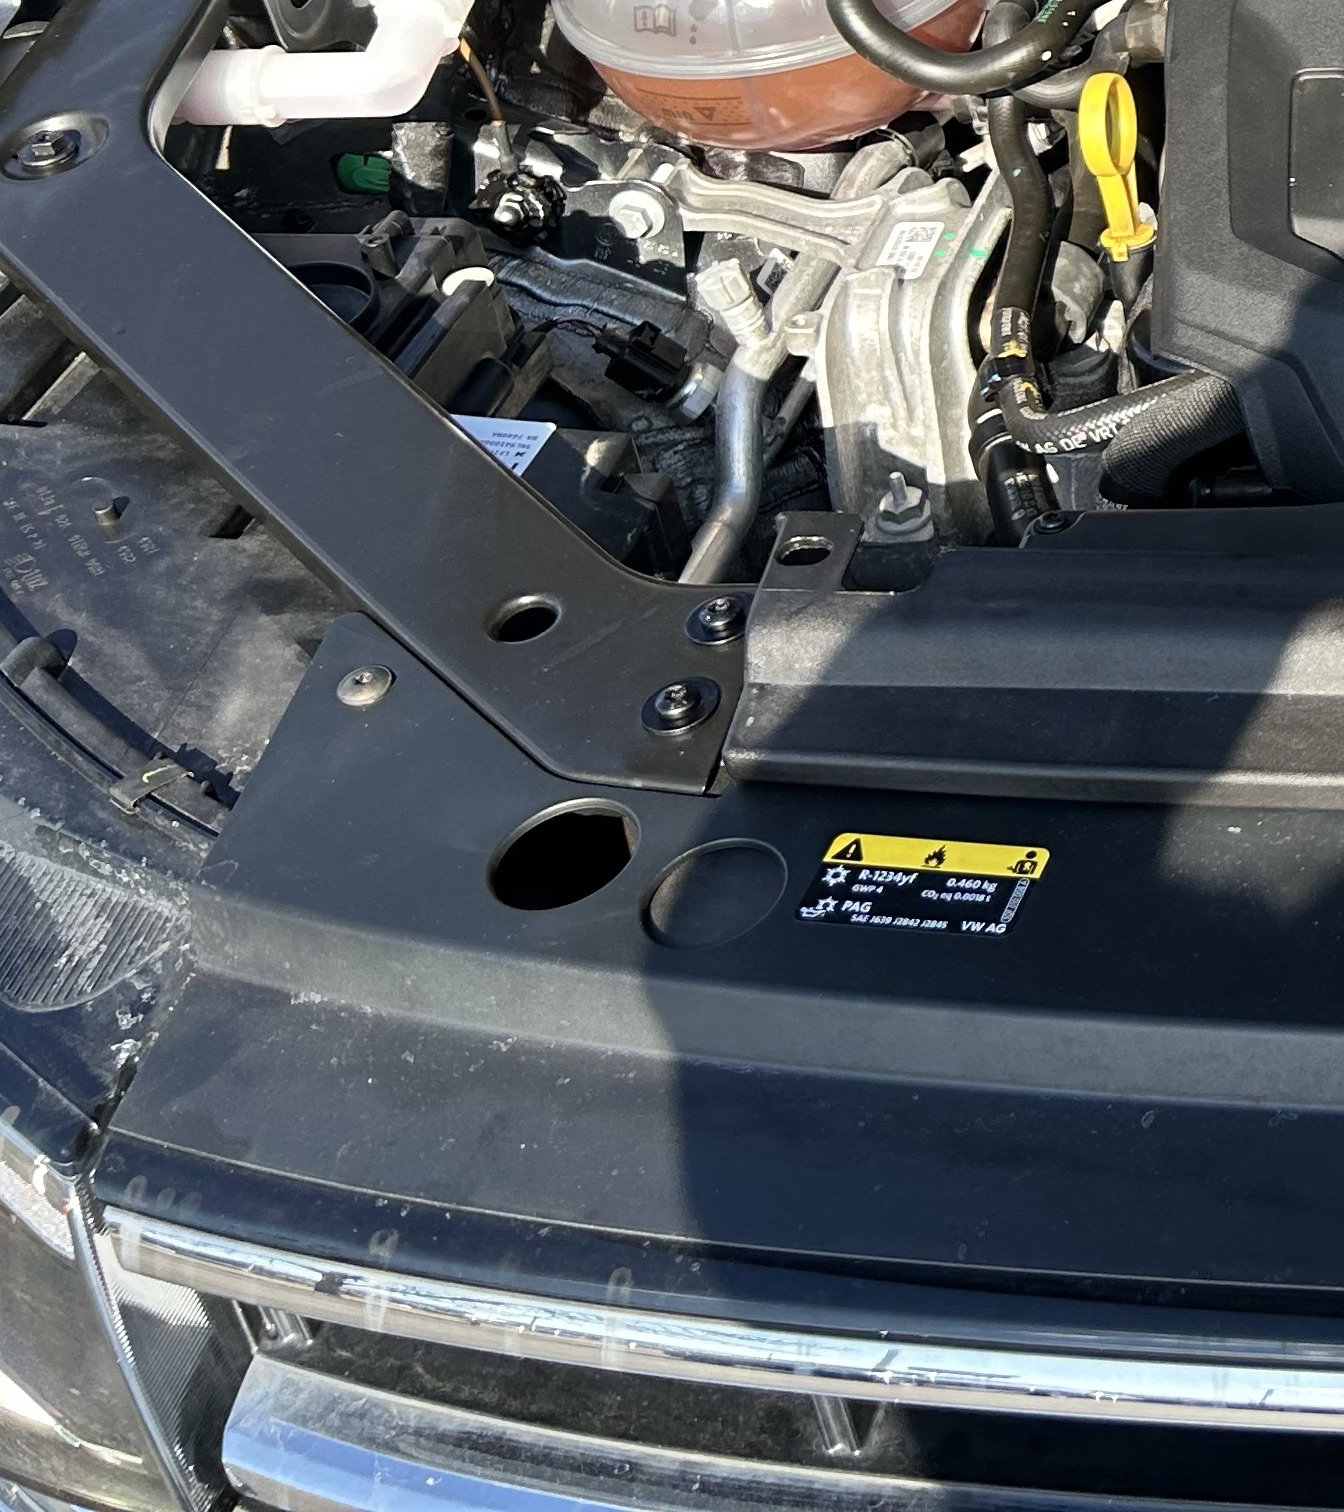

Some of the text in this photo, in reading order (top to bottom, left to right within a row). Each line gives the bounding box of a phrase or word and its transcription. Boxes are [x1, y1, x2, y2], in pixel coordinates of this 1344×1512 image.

[858, 869, 998, 892] R-1234yf 0.460 kg
[852, 884, 884, 894] GWP 4
[841, 900, 872, 913] PAG
[851, 914, 870, 923] SAE
[870, 916, 892, 924] J639
[961, 921, 1007, 934] VW AG
